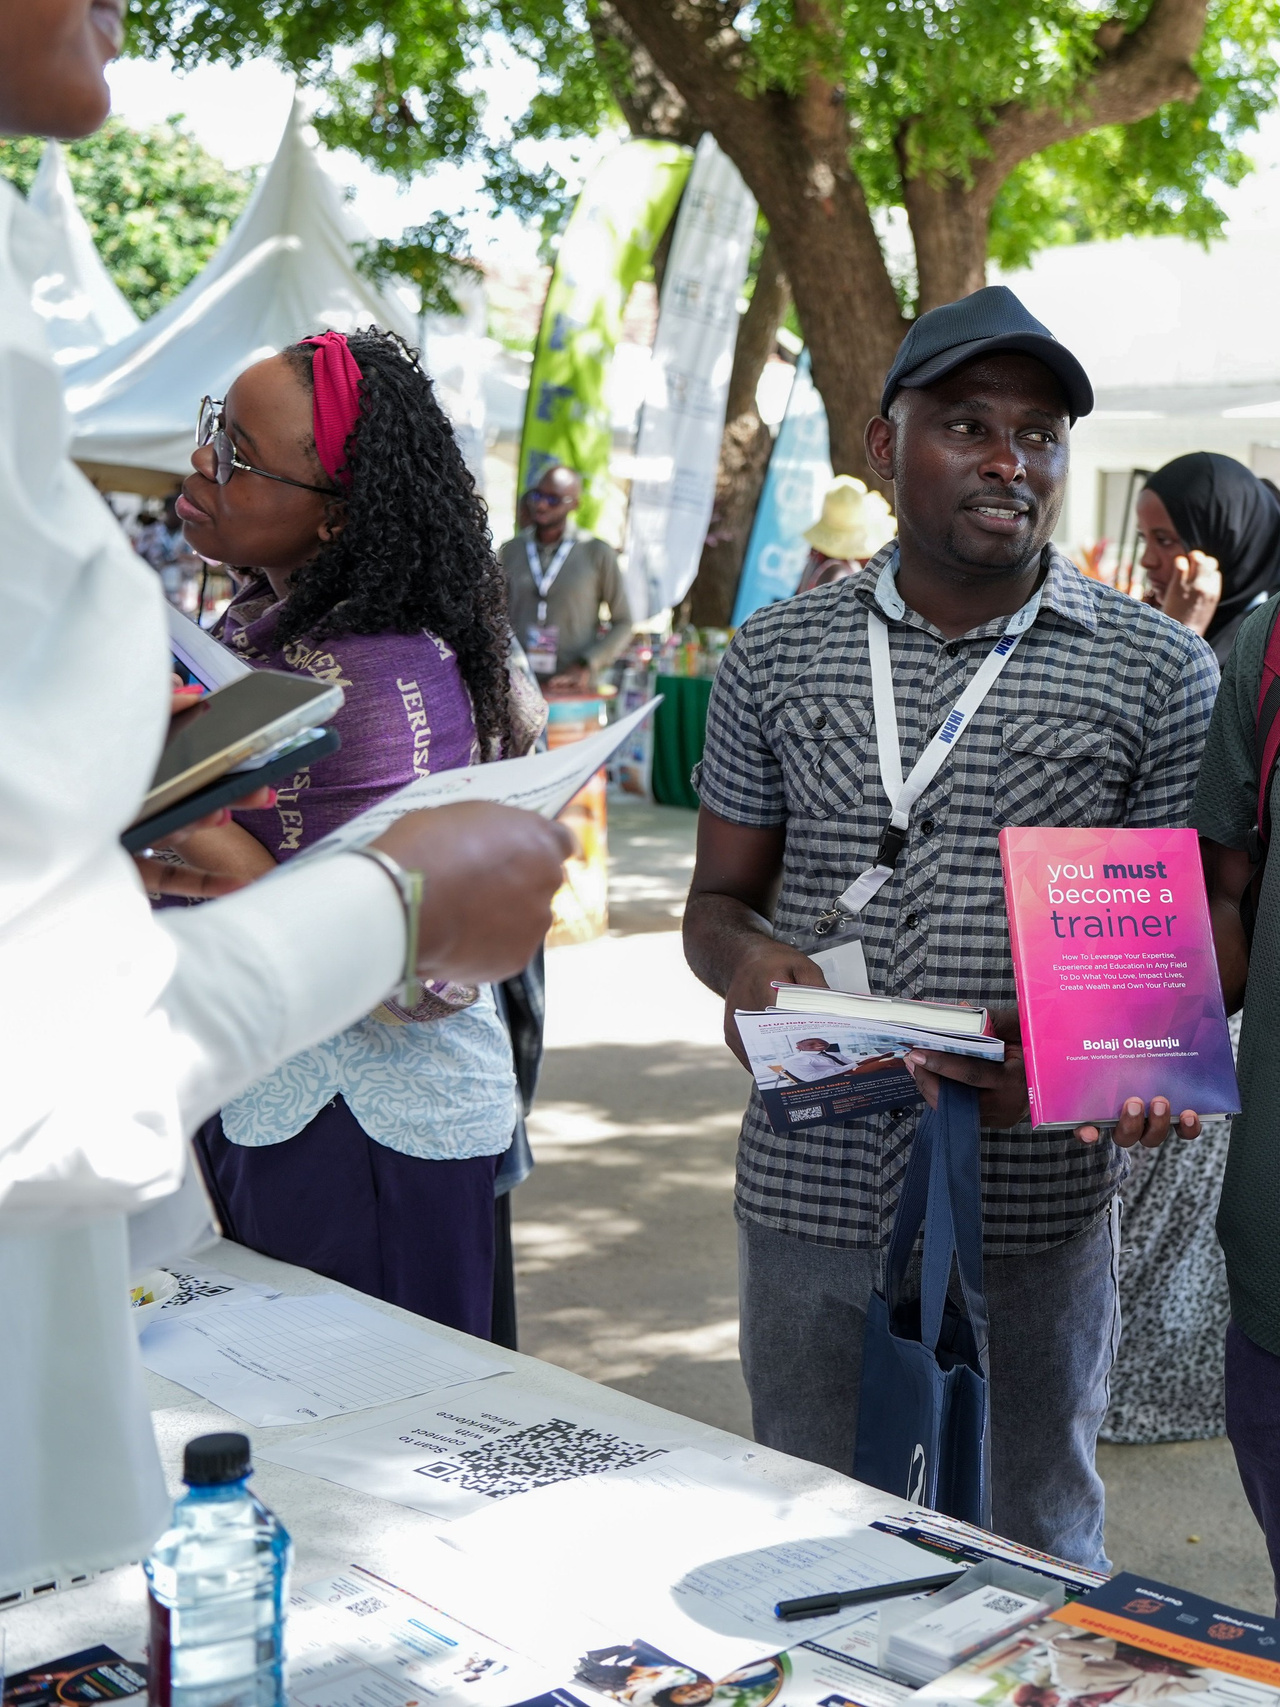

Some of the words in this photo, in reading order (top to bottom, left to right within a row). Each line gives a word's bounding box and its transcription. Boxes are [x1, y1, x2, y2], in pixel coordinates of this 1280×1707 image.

[938, 709, 965, 744] IHRM
[1047, 864, 1094, 883] you
[1103, 861, 1167, 879] must
[1048, 884, 1150, 904] become
[1160, 888, 1173, 903] a
[1050, 908, 1177, 938] trainer
[1083, 1039, 1119, 1051] Bolaji
[1123, 1037, 1180, 1049] Olagunju
[436, 1411, 501, 1434] Workforce
[481, 1412, 521, 1427] Africa.
[411, 1428, 466, 1446] connect
[455, 1428, 484, 1440] with
[414, 1441, 448, 1454] Scan
[1135, 1587, 1166, 1601] Focus
[1080, 1618, 1140, 1644] business
[1140, 1638, 1167, 1652] and
[1168, 1646, 1189, 1658] HR
[1189, 1653, 1241, 1672] trusted
